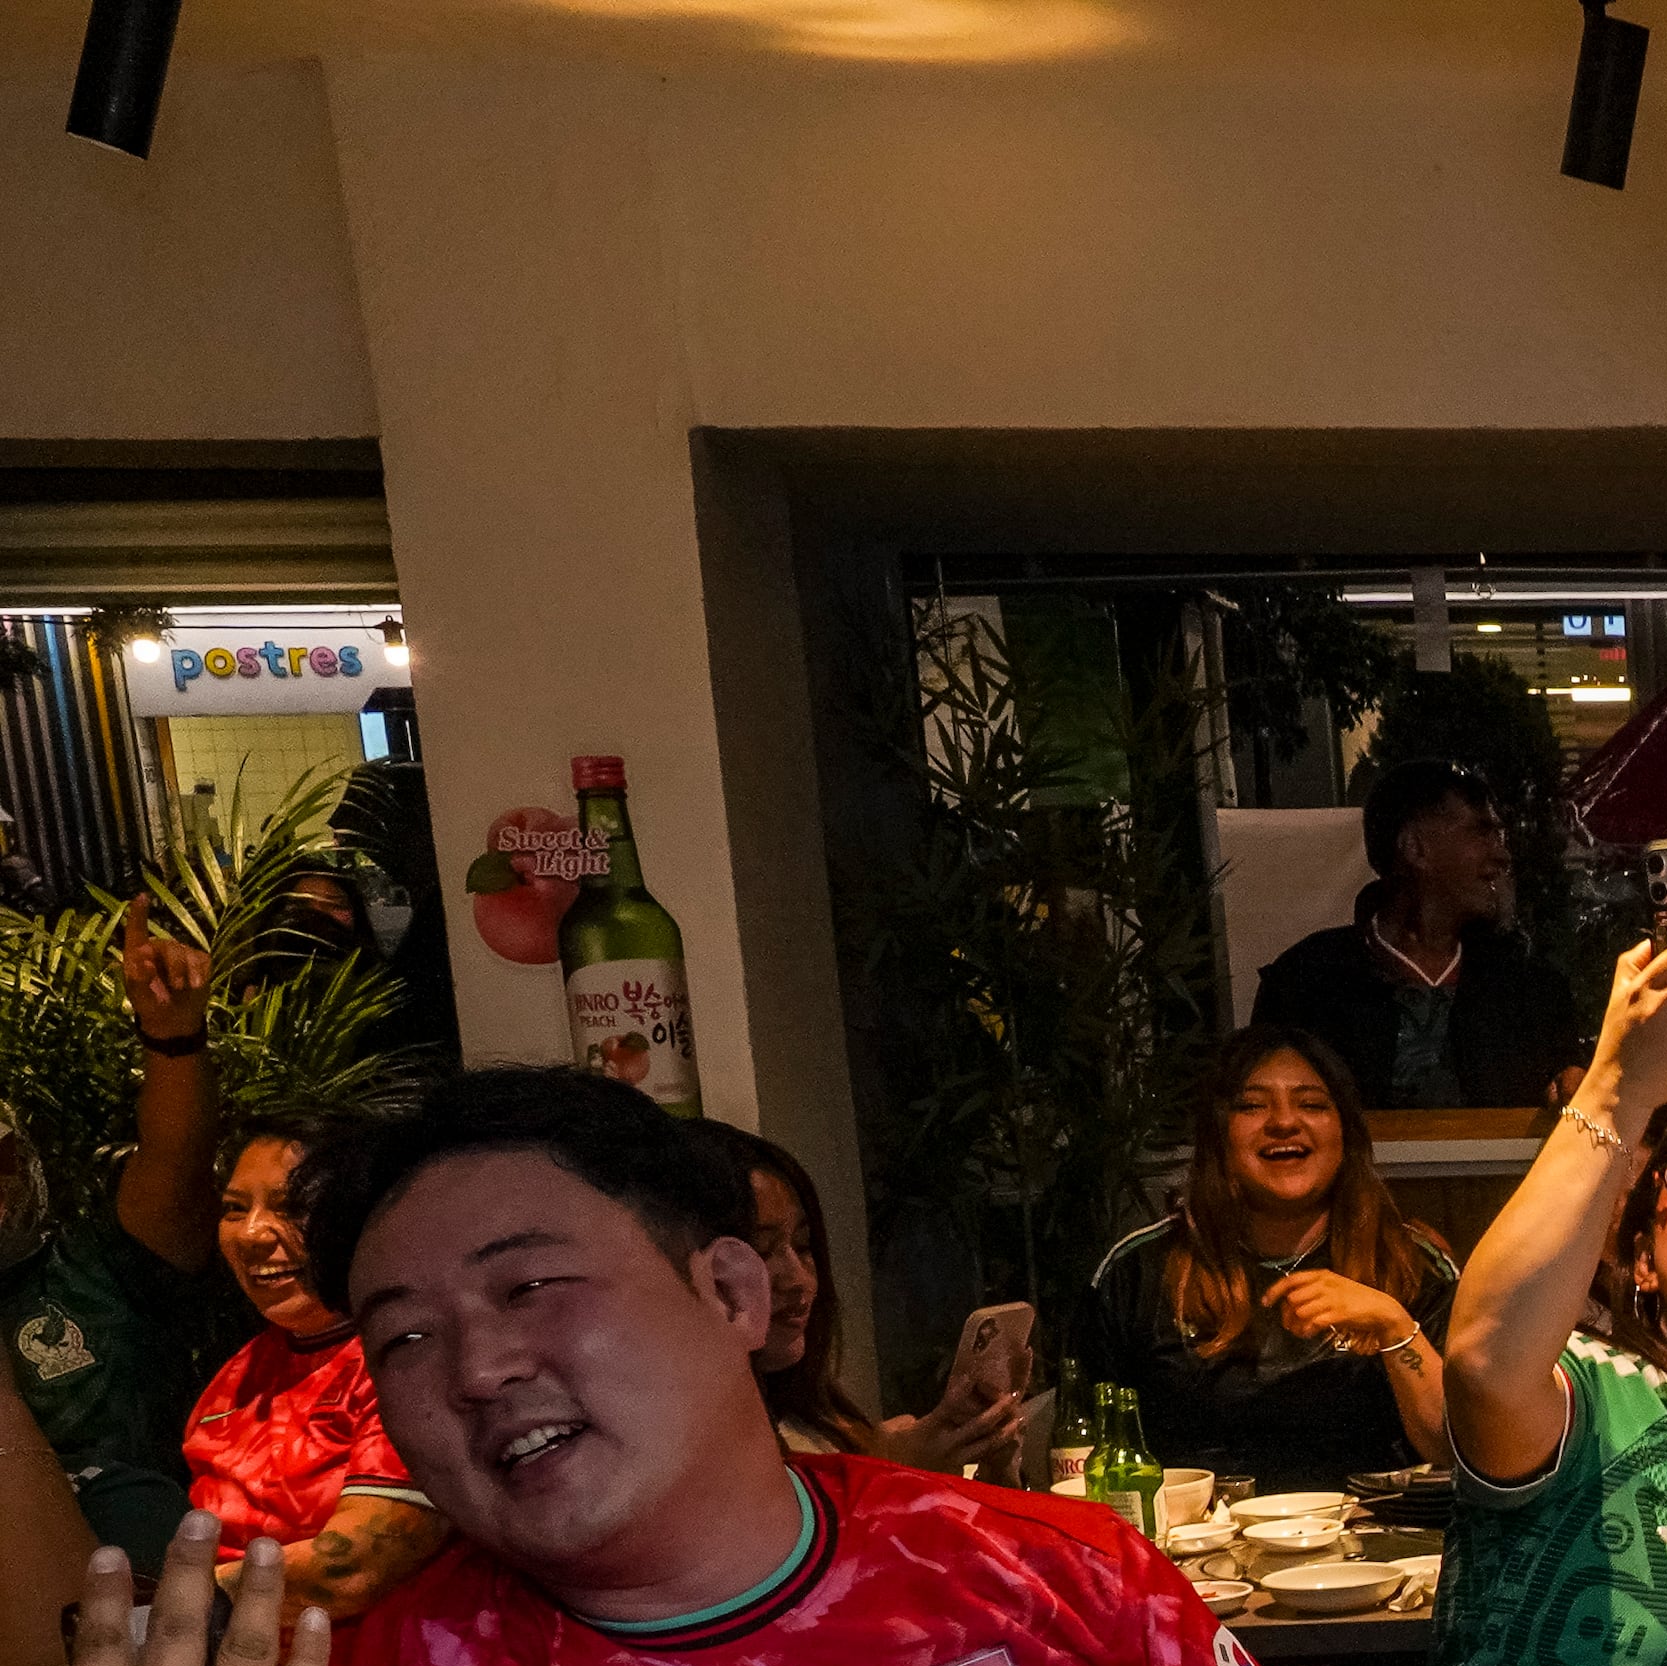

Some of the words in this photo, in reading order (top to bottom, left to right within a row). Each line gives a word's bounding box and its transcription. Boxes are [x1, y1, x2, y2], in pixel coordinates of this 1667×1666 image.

[171, 640, 363, 691] postres
[499, 826, 581, 851] Sweet
[584, 829, 609, 850] &
[534, 849, 611, 880] Light
